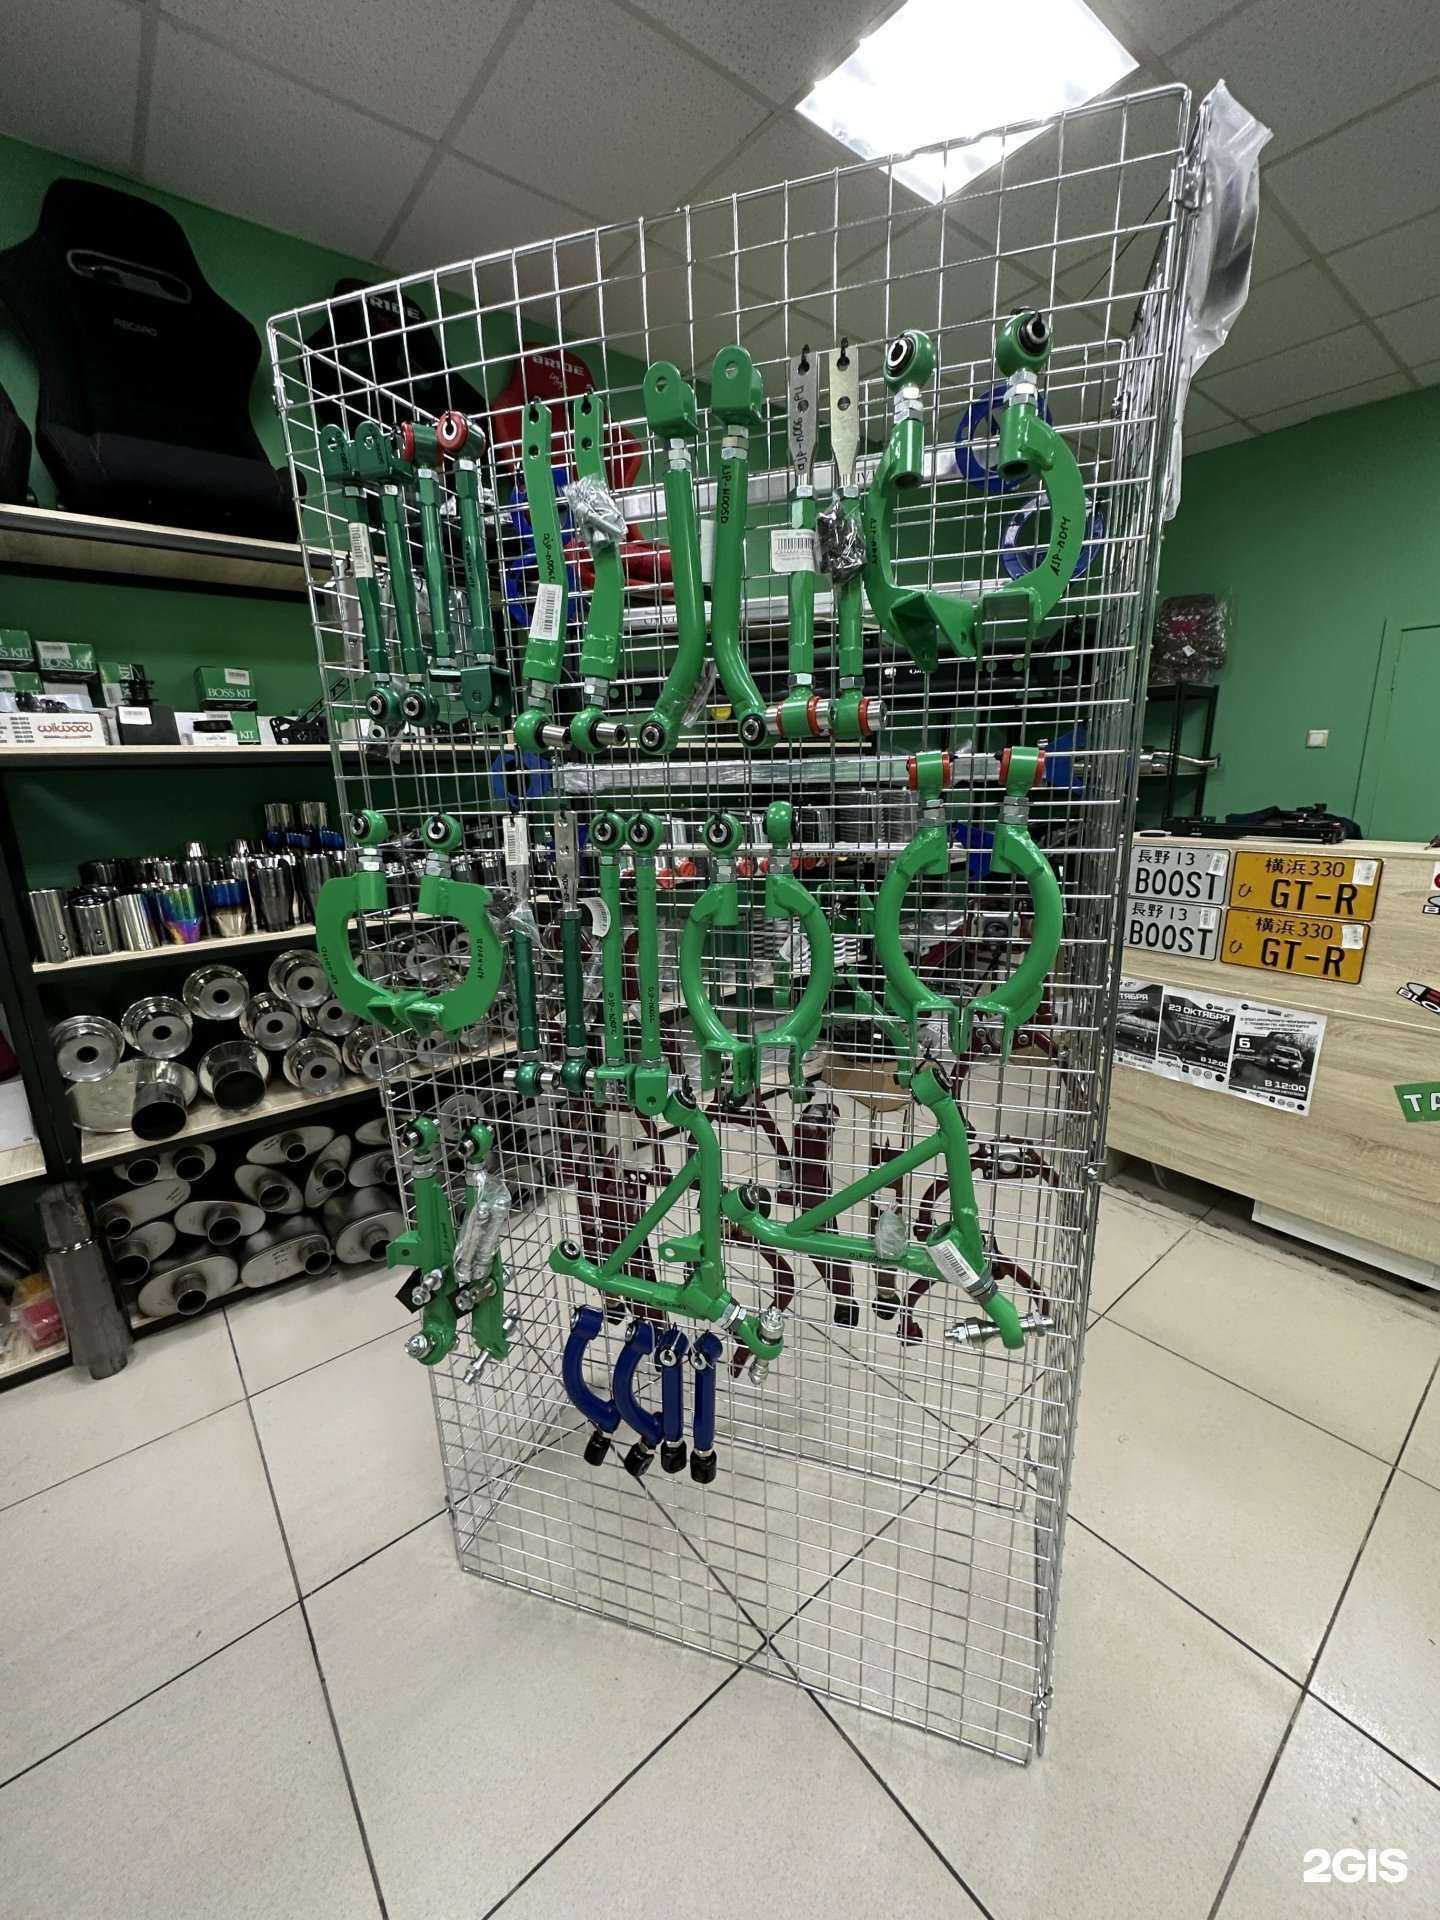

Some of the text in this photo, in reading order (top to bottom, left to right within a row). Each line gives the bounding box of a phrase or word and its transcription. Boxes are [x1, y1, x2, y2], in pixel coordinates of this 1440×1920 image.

[207, 687, 251, 699] BOSS KIT
[239, 730, 255, 740] KIT
[1137, 849, 1170, 865] 長野
[1135, 867, 1220, 900] BOOST
[1270, 879, 1358, 915] GT-R
[1132, 902, 1164, 919] 長野
[1129, 919, 1214, 956] BOOST
[1260, 937, 1346, 977] GT-R
[1119, 992, 1149, 1001] ТЯБРЯ
[1168, 1004, 1182, 1012] 23
[1183, 1006, 1230, 1023] ОКТЯБРЯ
[1238, 1037, 1251, 1048] 6
[1274, 1081, 1306, 1093] 12:00
